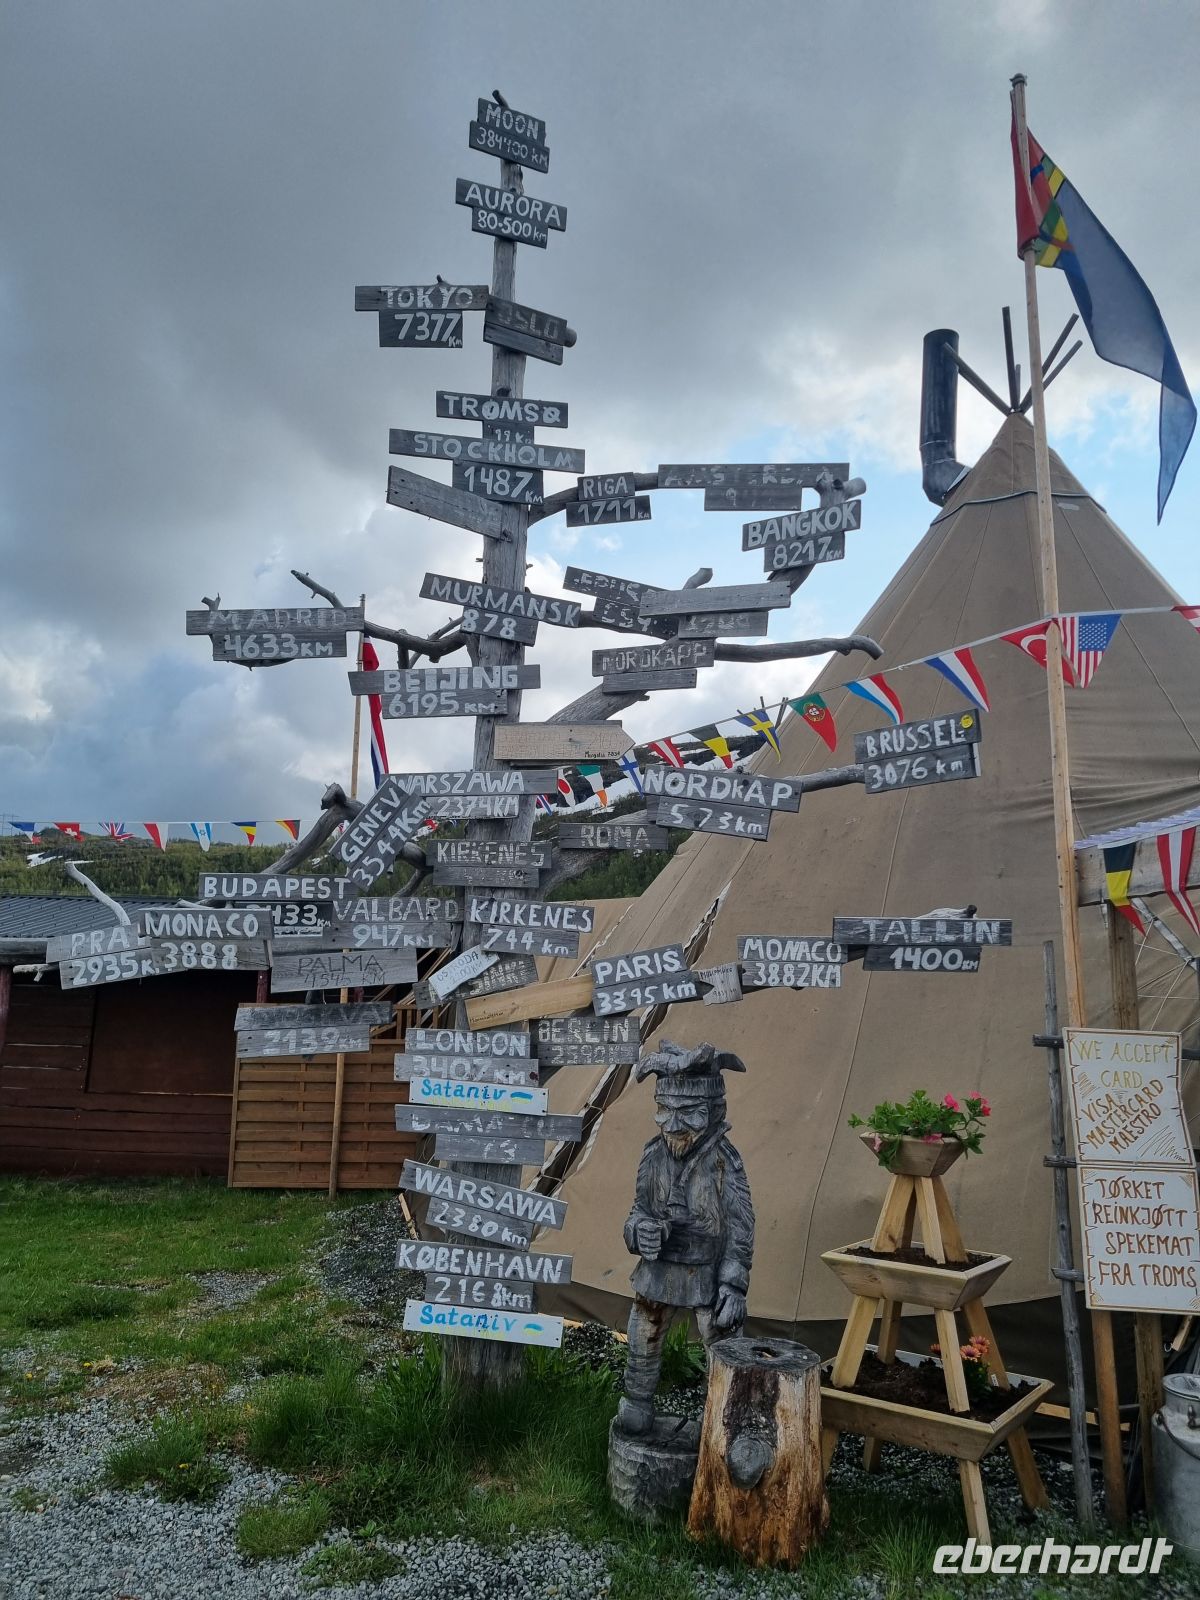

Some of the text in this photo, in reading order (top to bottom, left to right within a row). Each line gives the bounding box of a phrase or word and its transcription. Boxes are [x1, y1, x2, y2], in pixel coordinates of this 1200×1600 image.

[485, 103, 539, 140] MOON
[464, 183, 561, 226] AURORA
[380, 286, 473, 309] TOKYO
[394, 312, 461, 341] 7377
[414, 434, 574, 470] STOCKHOLM
[463, 464, 533, 499] 1487
[577, 500, 637, 524] 1711
[747, 501, 858, 548] BANGKOK
[772, 535, 833, 569] 8217
[430, 577, 581, 628] MURMANSK
[207, 608, 347, 630] MADRID
[463, 609, 518, 640] 878
[224, 633, 299, 659] 4633
[383, 665, 519, 694] BEIJING
[388, 692, 460, 717] 6195
[390, 771, 525, 796] WARSZAWA
[871, 756, 963, 789] 3076 km
[340, 787, 401, 863] GENEV
[670, 803, 763, 834] 573 km
[580, 825, 652, 849] ROMA
[437, 841, 545, 867] KIRKENES
[204, 876, 351, 900] BUDAPEST
[144, 912, 259, 938] MONACO
[470, 898, 593, 933] KIRKENES
[352, 923, 404, 947] 947
[483, 927, 569, 955] 744 km
[862, 920, 1001, 943] TALLIN
[160, 941, 238, 970] 3888
[742, 938, 842, 961] MONACO
[889, 947, 963, 971] 1400
[71, 951, 140, 986] 2935
[297, 954, 384, 976] PALMA
[594, 950, 684, 984] PARIS
[662, 980, 696, 1000] km
[415, 1030, 527, 1057] LONDON
[1075, 1040, 1174, 1064] WE ACCEPT
[1100, 1069, 1144, 1090] CARD
[1085, 1079, 1165, 1150] MASTERCARD
[1108, 1101, 1162, 1155] MAESTRO
[415, 1167, 557, 1225] WARSAWA
[1095, 1175, 1166, 1201] TØRKET
[433, 1202, 528, 1247] 2380 km
[1105, 1232, 1195, 1256] SPEKEMAT
[398, 1242, 564, 1283] KØBENHAVN
[1098, 1262, 1134, 1287] FRA
